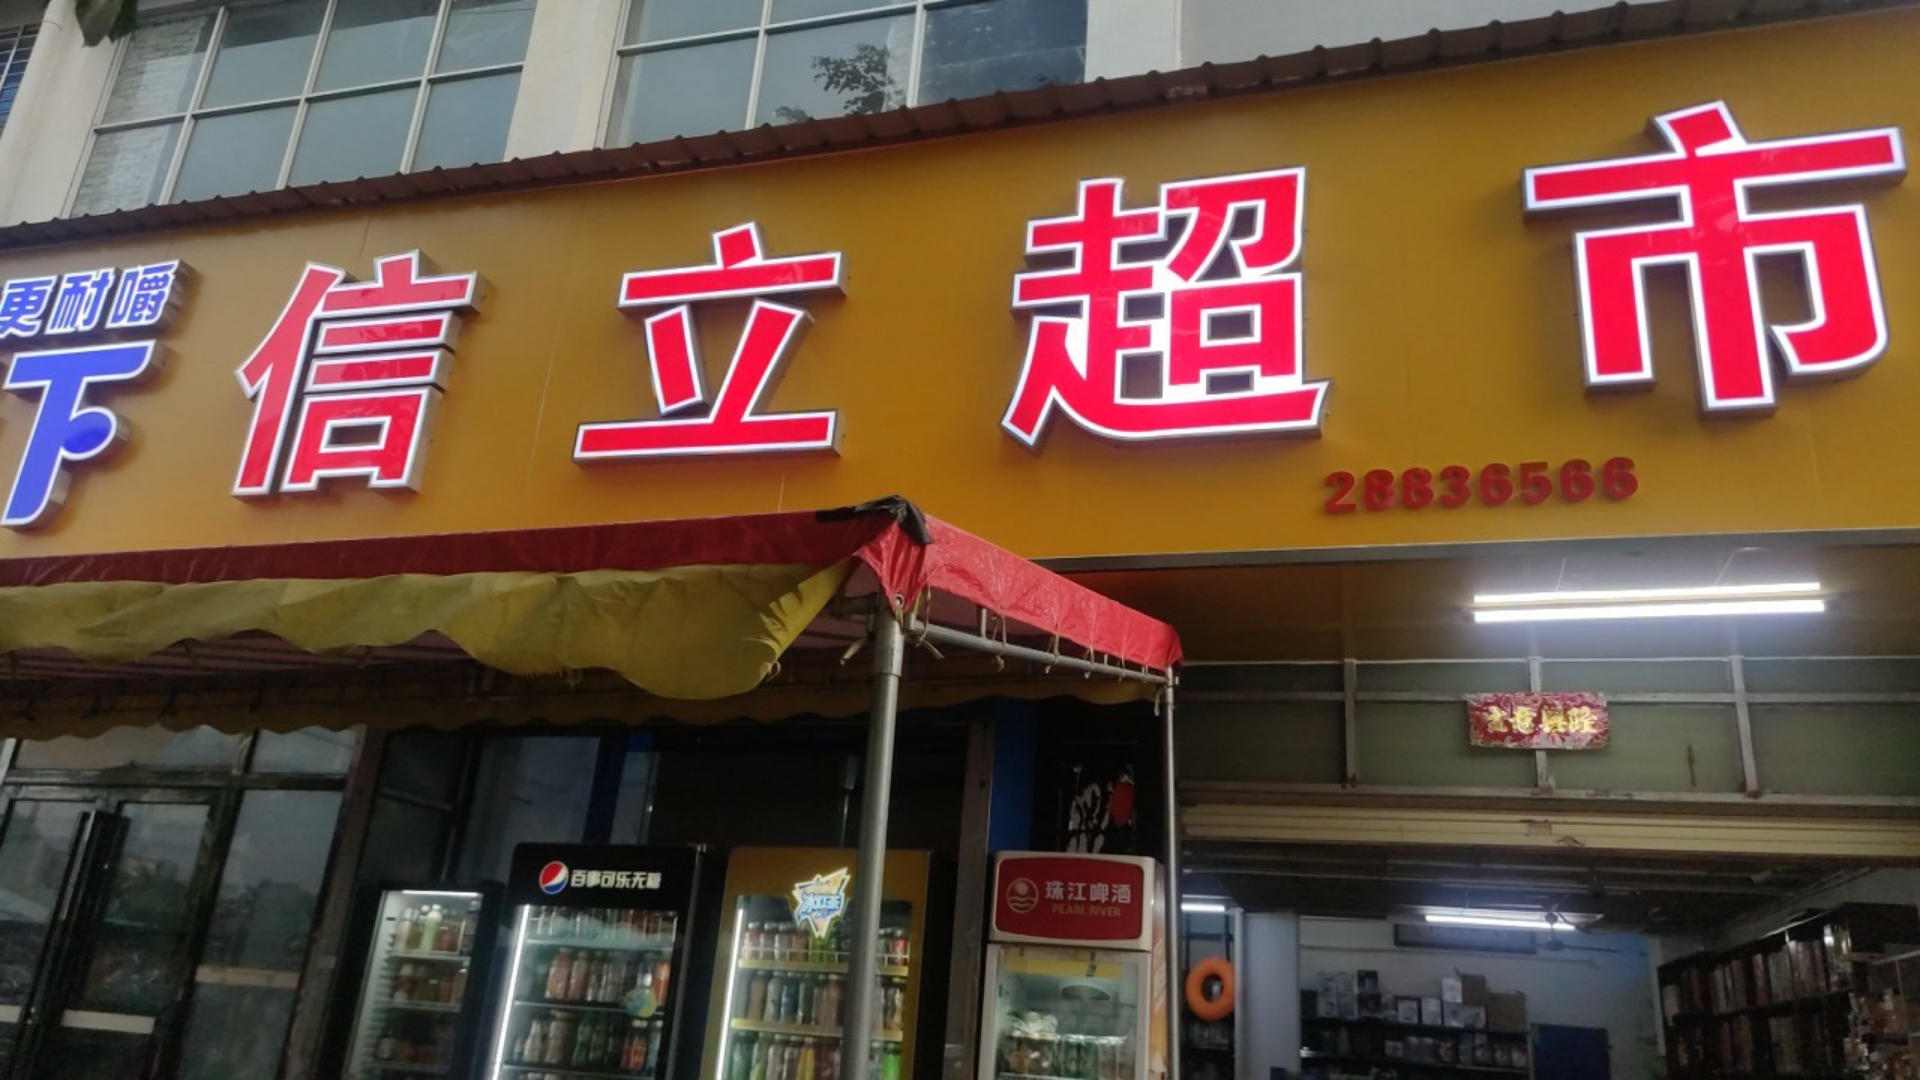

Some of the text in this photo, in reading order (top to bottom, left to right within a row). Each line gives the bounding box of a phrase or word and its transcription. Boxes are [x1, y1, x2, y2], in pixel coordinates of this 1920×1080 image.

[0, 259, 180, 339] 更耐嚼
[231, 101, 1906, 496] 信立超市
[1325, 457, 1639, 515] 28836566
[570, 869, 662, 890] 百事可乐无糖
[1045, 880, 1132, 904] 珠江啤酒
[1052, 903, 1122, 918] PEARL RIVER
